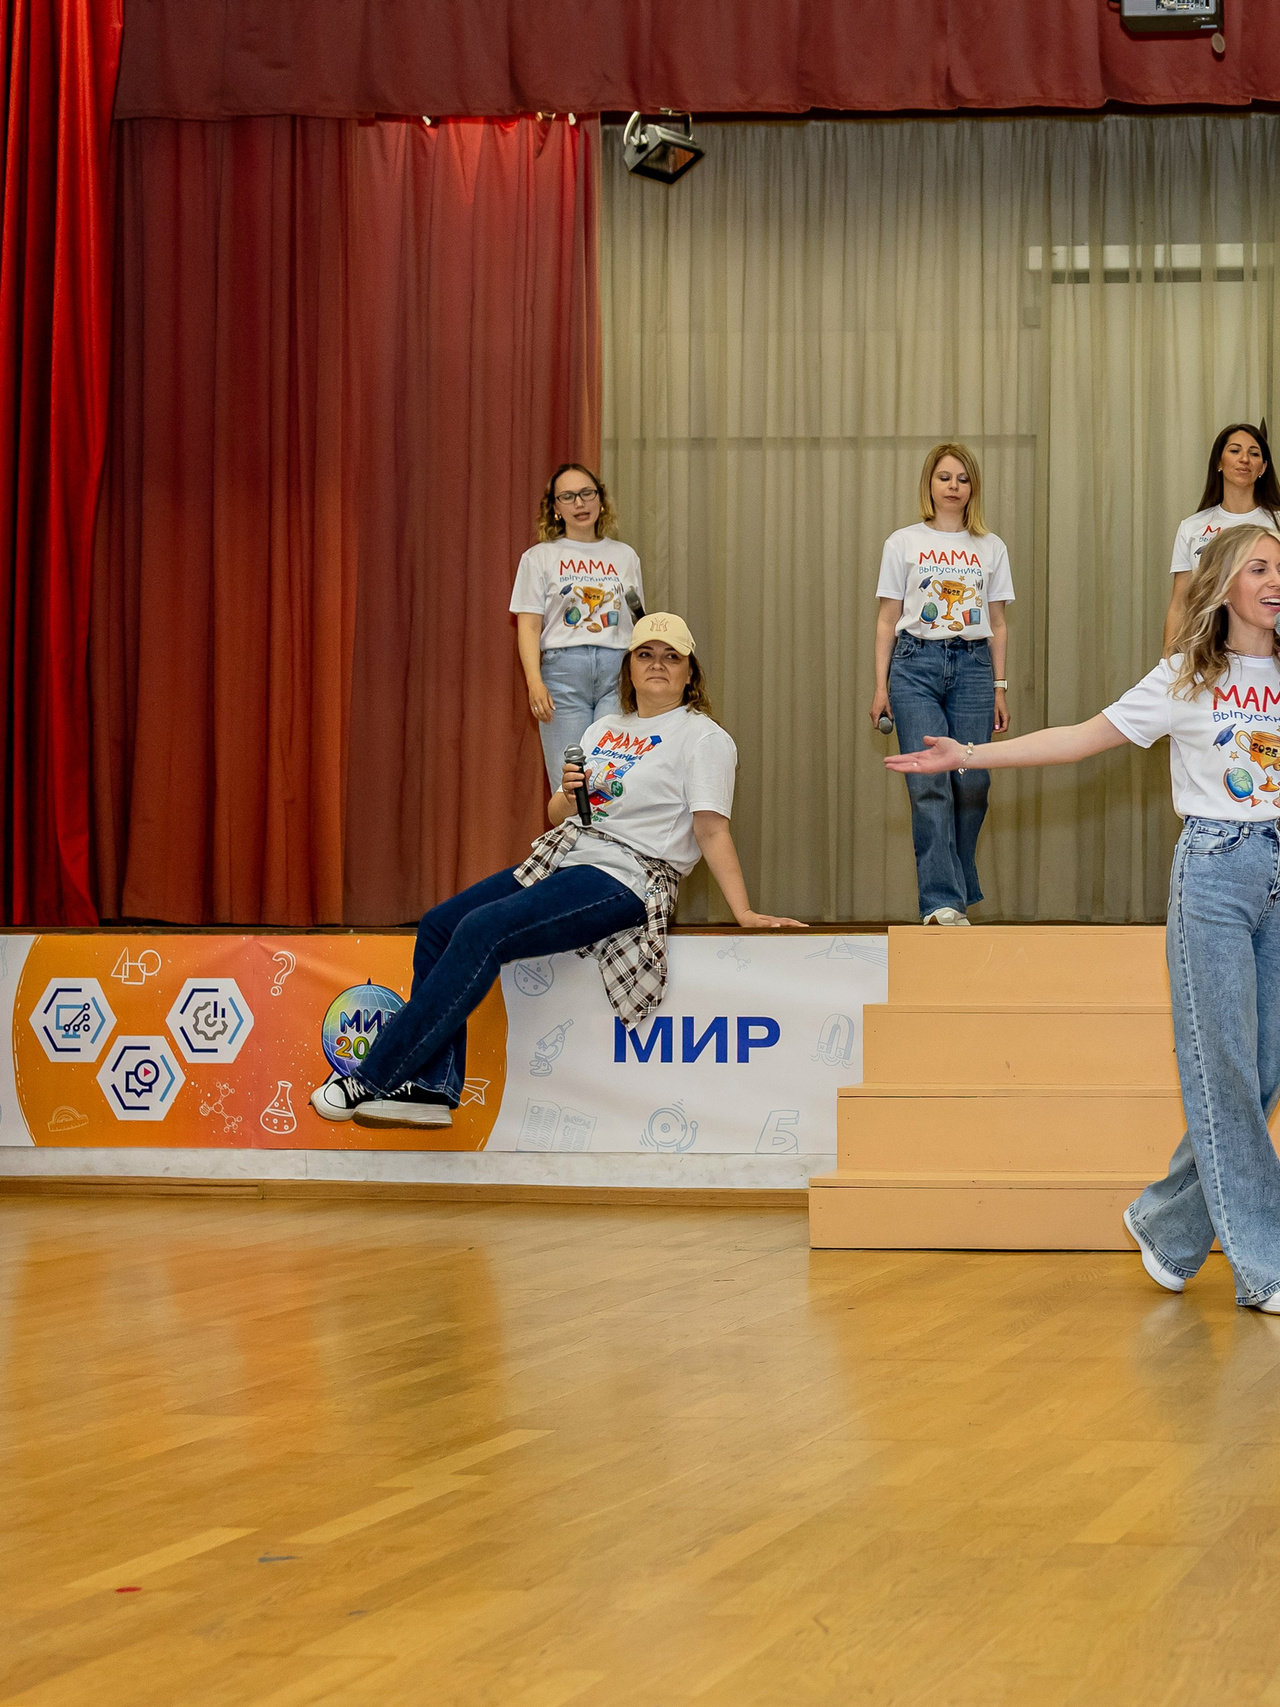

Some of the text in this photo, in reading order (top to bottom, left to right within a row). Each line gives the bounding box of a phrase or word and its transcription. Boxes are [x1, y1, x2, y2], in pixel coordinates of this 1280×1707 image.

[560, 559, 618, 576] МАМА
[919, 550, 982, 568] МАМА
[1252, 743, 1279, 758] 2025
[613, 1016, 781, 1064] МИР
